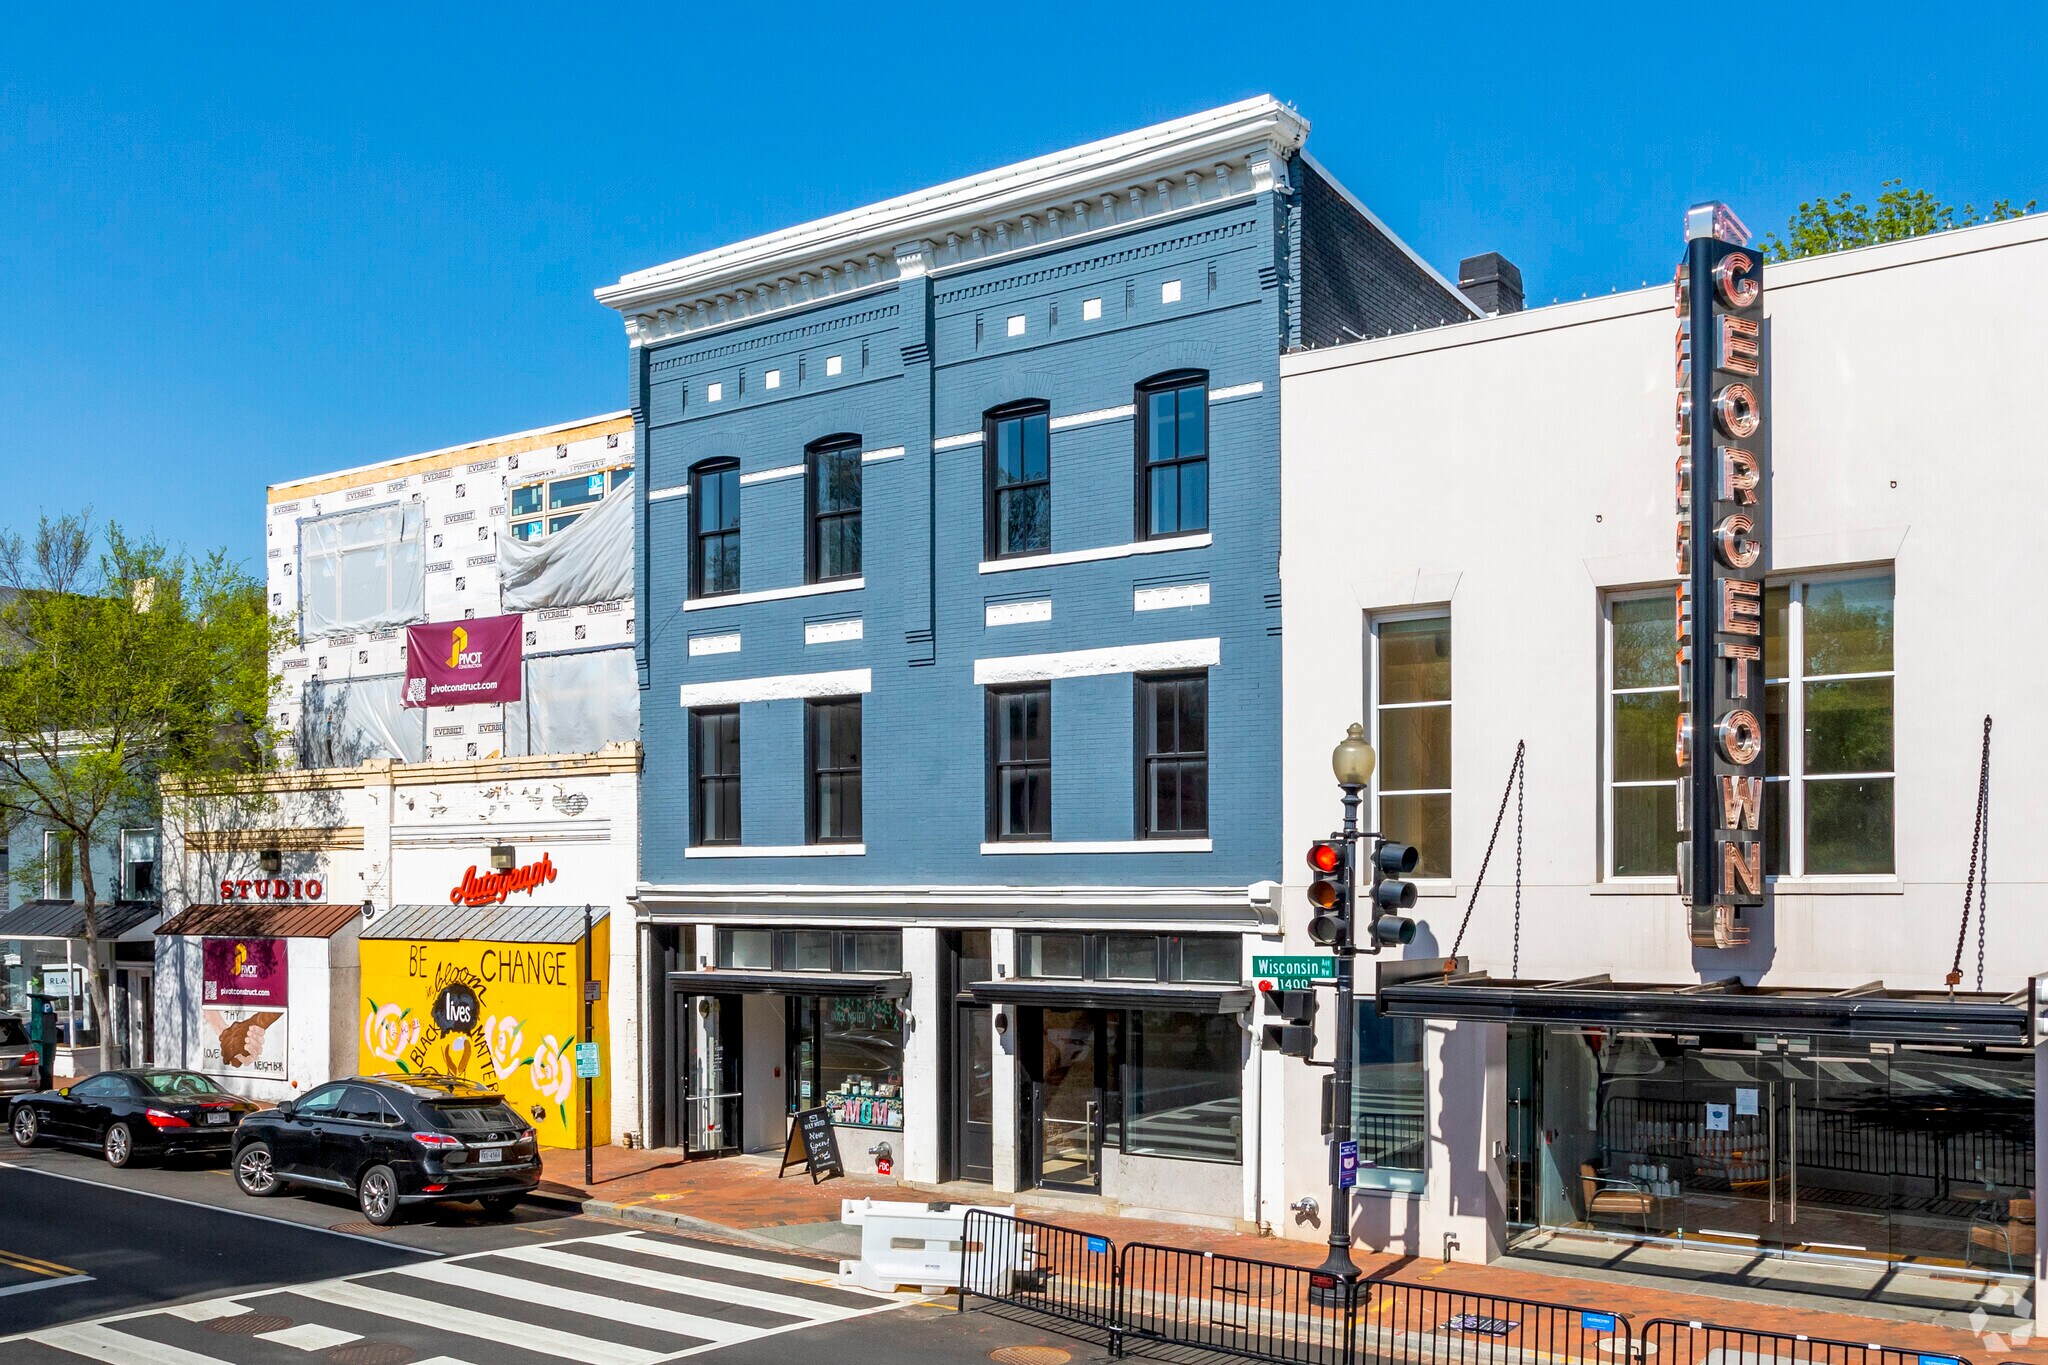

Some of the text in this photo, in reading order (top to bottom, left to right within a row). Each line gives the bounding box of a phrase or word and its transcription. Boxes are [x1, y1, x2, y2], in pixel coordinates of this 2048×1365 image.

[468, 460, 497, 473] EVERBILT
[423, 469, 452, 483] EVERBILT
[445, 511, 474, 524] EVERBILT
[425, 561, 452, 573] VERBILT
[468, 554, 496, 567] EVERBILT
[1713, 251, 1763, 897] GEORGETOWN
[539, 609, 571, 621] EVERBILT
[589, 602, 622, 615] EVERBILT
[459, 651, 482, 665] PIVOT
[431, 681, 498, 695] pivotconstruct.com
[434, 726, 463, 736] EVERBILT
[450, 852, 557, 906] Autograph
[220, 879, 323, 900] STUDIO
[409, 945, 428, 978] BE
[480, 949, 567, 986] CHANGE
[1258, 959, 1319, 975] Wisconsin
[50, 977, 67, 985] RLA
[435, 961, 487, 1008] bloom
[1279, 979, 1309, 990] 1400
[220, 987, 271, 997] pivotconstruct.com
[446, 992, 471, 1023] lives
[224, 1010, 240, 1021] THY
[410, 1020, 441, 1068] BLACK
[203, 1048, 220, 1059] LOVE
[471, 1024, 499, 1092] MATTER
[845, 1099, 888, 1126] MOM
[878, 1161, 890, 1172] FDC
